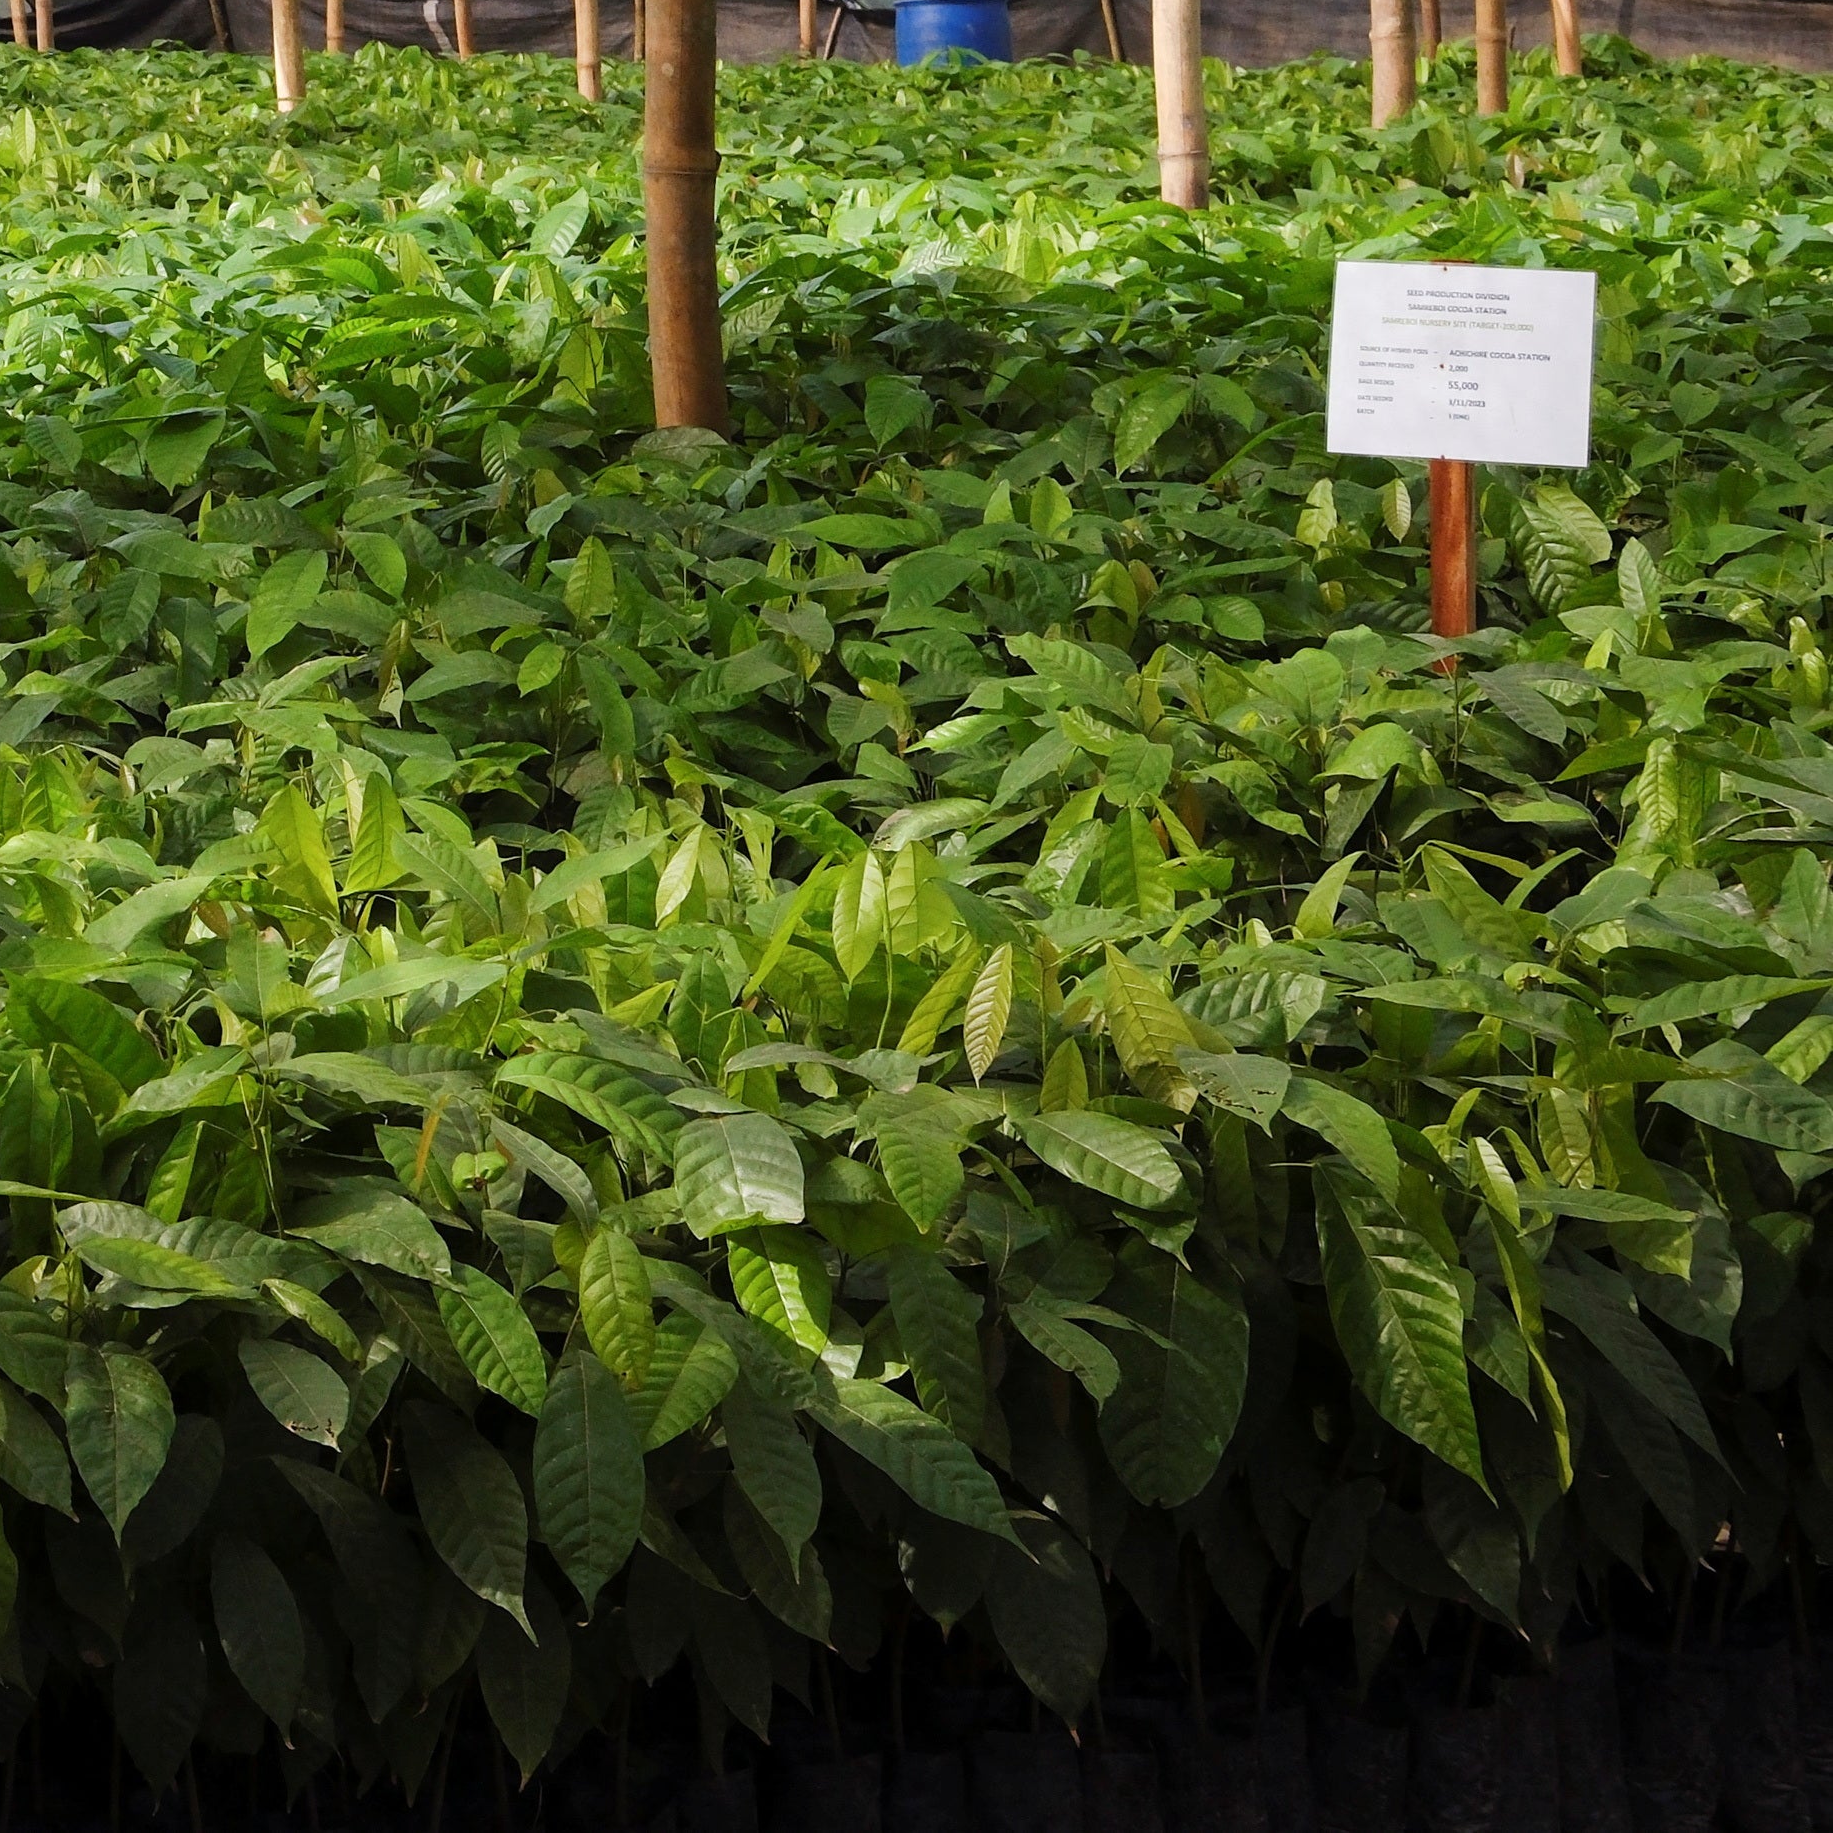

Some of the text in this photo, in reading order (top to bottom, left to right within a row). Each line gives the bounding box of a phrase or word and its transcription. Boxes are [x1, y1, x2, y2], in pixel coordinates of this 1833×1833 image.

[1425, 290, 1473, 299] PRODUCTION
[1447, 305, 1473, 313] COCOA
[1475, 306, 1507, 315] STATION
[1419, 319, 1451, 327] NURSERY
[1453, 320, 1466, 328] SITE
[1490, 352, 1516, 360] COCOA
[1517, 353, 1550, 361] STATION
[1448, 381, 1479, 391] 55,000
